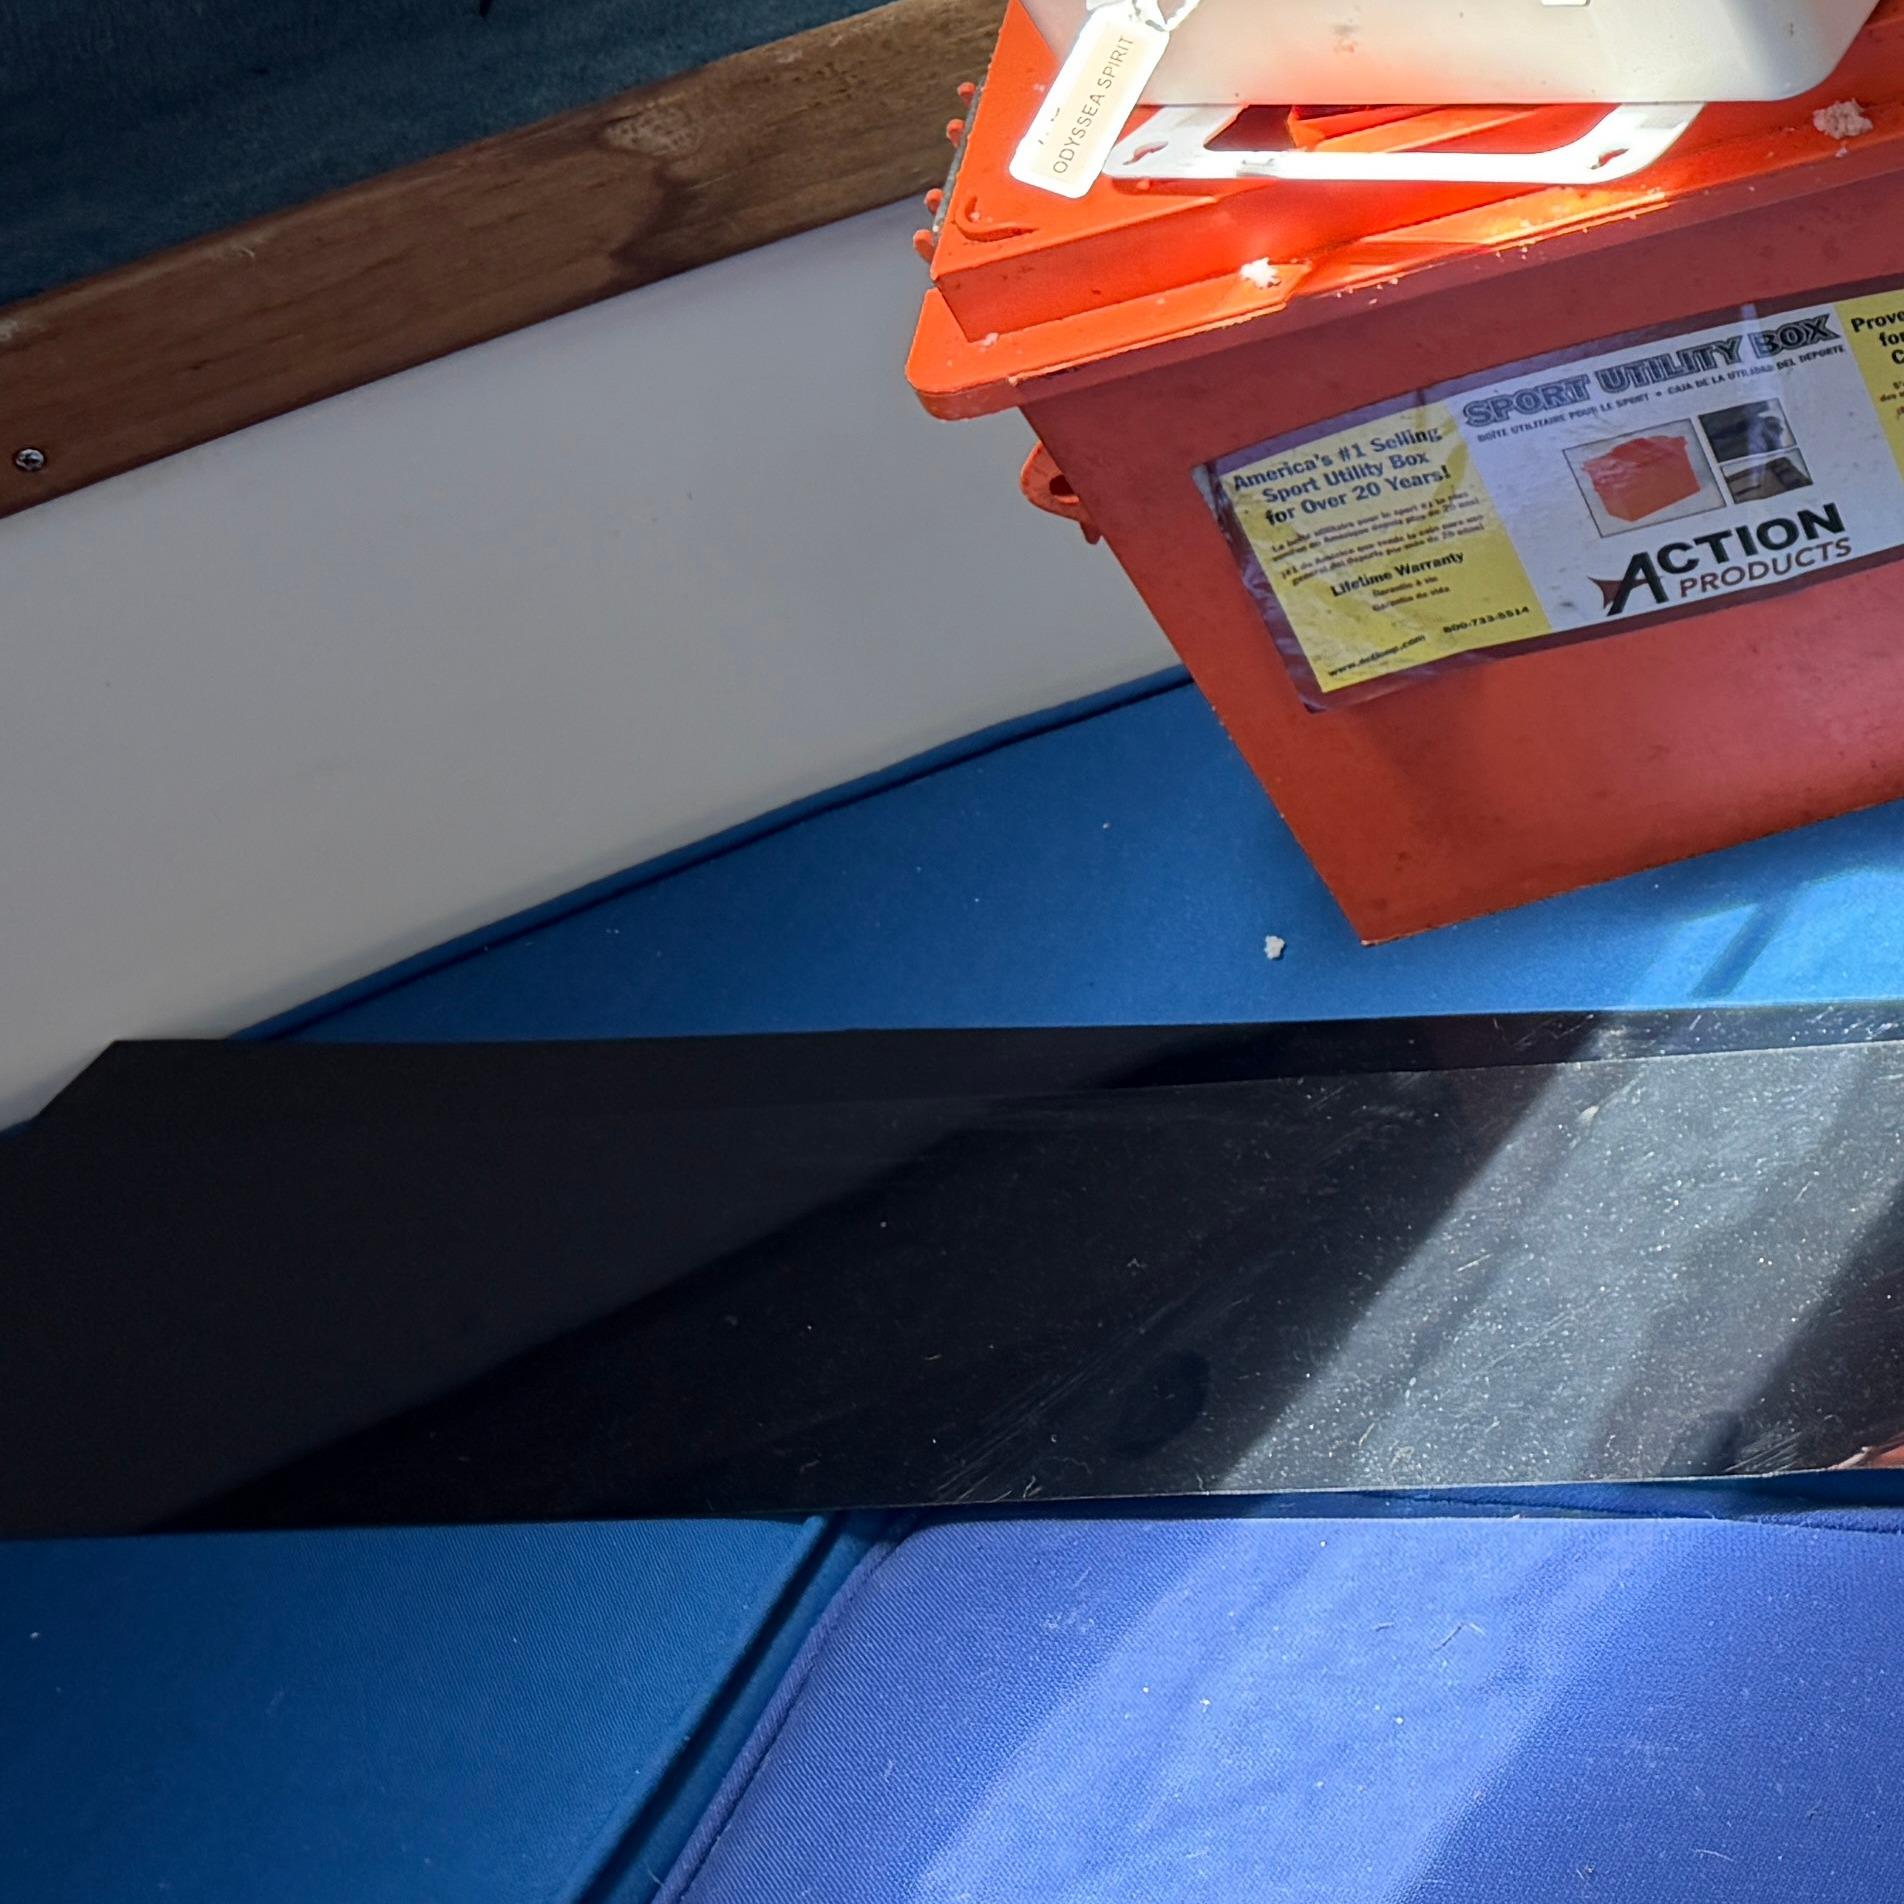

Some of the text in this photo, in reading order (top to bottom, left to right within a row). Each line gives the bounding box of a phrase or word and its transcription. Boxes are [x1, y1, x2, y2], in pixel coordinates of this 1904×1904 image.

[1053, 35, 1134, 174] ODYSSEA SPIRIT
[1461, 313, 1841, 428] SPORT UTILITY BOX
[1233, 426, 1443, 492] America's #1 Selling
[1261, 452, 1430, 505] Sport Utility Box
[1264, 464, 1451, 527] for Over 20 Years!
[1330, 551, 1465, 599] Lifetime Warranty
[1605, 501, 1848, 618] ACTION
[1678, 536, 1853, 599] PRODUCTS
